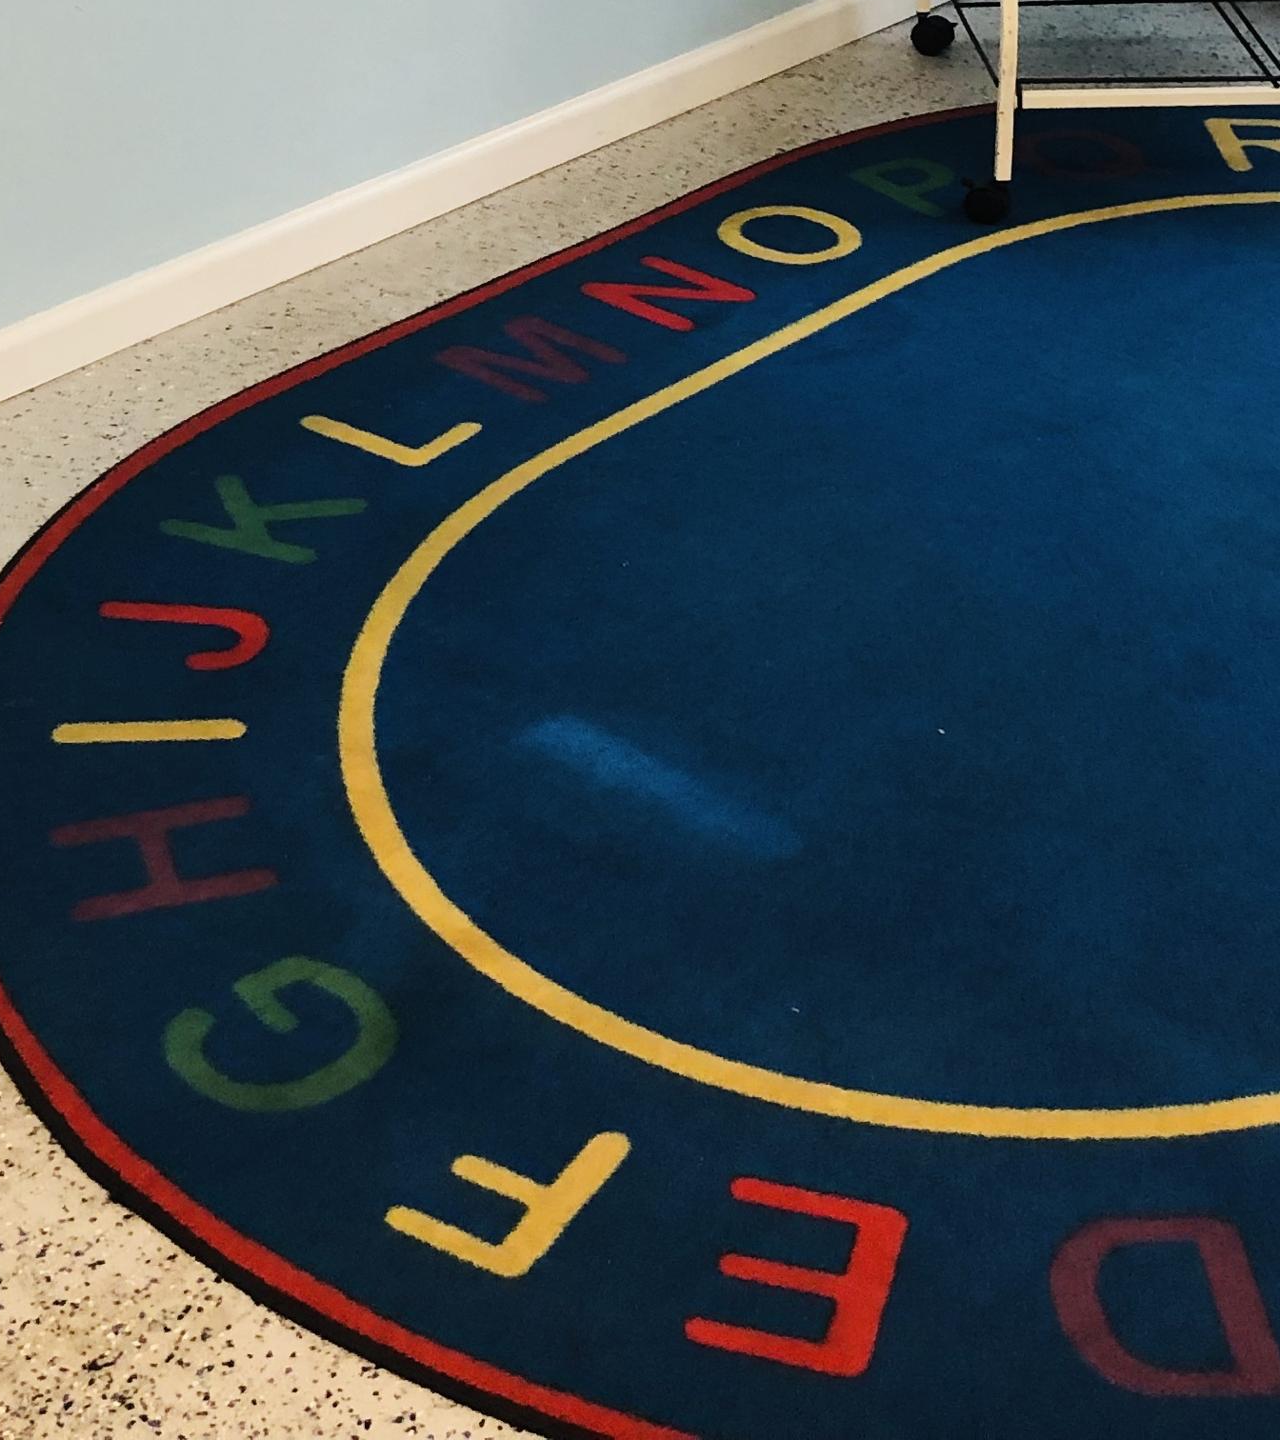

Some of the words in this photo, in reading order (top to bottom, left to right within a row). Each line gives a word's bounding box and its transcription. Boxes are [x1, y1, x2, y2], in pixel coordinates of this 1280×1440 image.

[717, 204, 862, 266] O
[581, 256, 757, 332] N
[437, 315, 629, 402] M
[300, 415, 483, 466] L
[159, 476, 368, 563] K
[99, 601, 271, 671] J
[48, 795, 277, 922] H
[162, 956, 399, 1112] G
[385, 1131, 631, 1278] F
[684, 1177, 908, 1377] E
